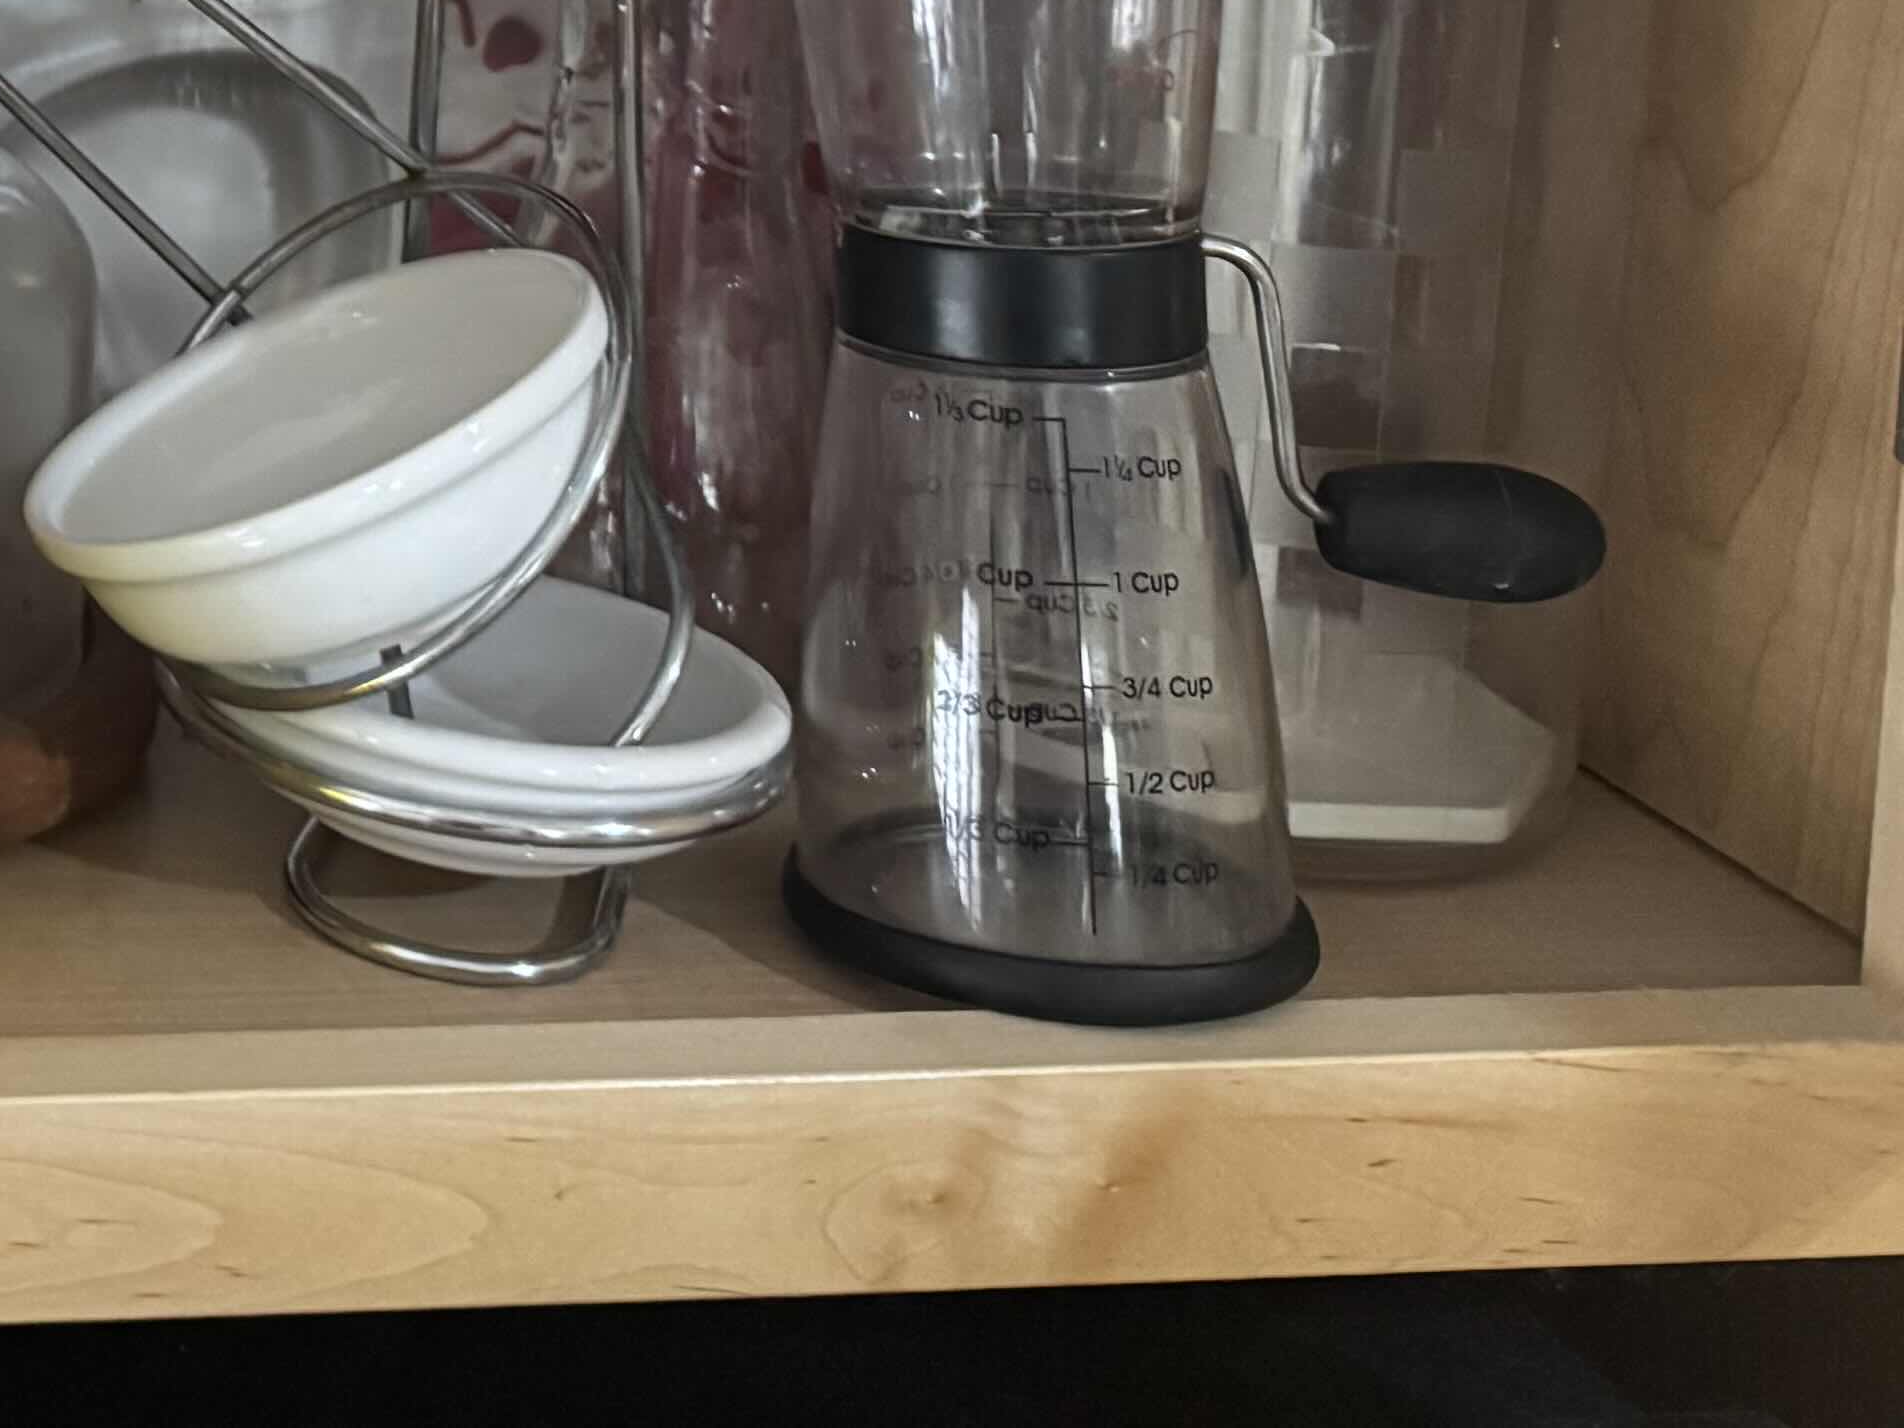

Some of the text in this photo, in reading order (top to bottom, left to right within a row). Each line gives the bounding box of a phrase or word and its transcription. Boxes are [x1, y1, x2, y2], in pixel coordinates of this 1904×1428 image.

[967, 399, 1024, 429] Cup
[1137, 455, 1182, 481] Cup
[977, 562, 1034, 591] Cup
[1112, 571, 1180, 596] 1 Cup
[1122, 675, 1214, 700] 3/4 Cup
[936, 689, 981, 716] 2/3
[986, 698, 1037, 728] Cup
[1126, 770, 1215, 794] 1/2 Cup
[994, 821, 1051, 851] Cup
[1172, 862, 1218, 886] Cup
